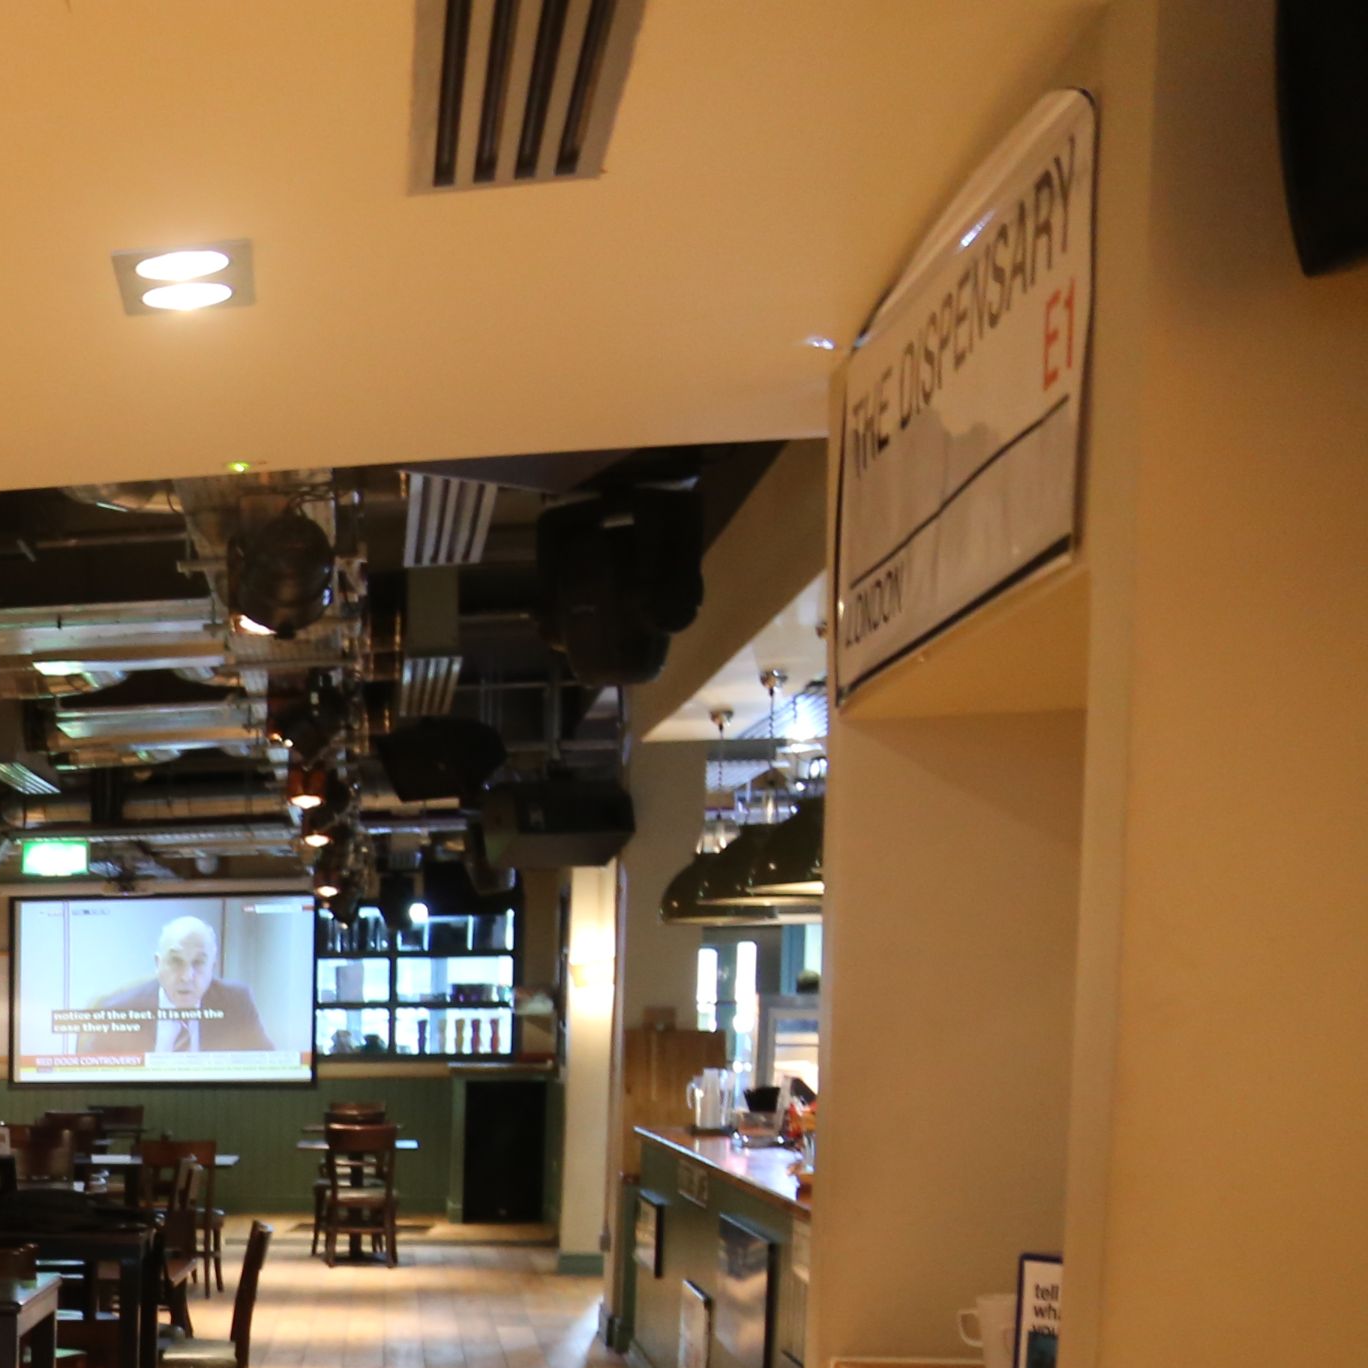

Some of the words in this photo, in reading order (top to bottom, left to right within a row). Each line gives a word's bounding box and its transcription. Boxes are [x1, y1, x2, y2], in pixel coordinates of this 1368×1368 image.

[851, 365, 894, 481] THE
[899, 134, 1076, 432] DISPENSARY
[1043, 277, 1076, 391] E1
[844, 560, 905, 648] LONDON
[54, 1010, 92, 1020] notice
[93, 1010, 106, 1020] of
[107, 1010, 126, 1020] the
[157, 1009, 167, 1019] It
[169, 1009, 179, 1019] is
[181, 1009, 202, 1019] not
[203, 1009, 224, 1019] the
[82, 1022, 108, 1033] they
[111, 1022, 141, 1032] have
[1034, 1283, 1059, 1301] tell
[1033, 1303, 1061, 1321] wh
